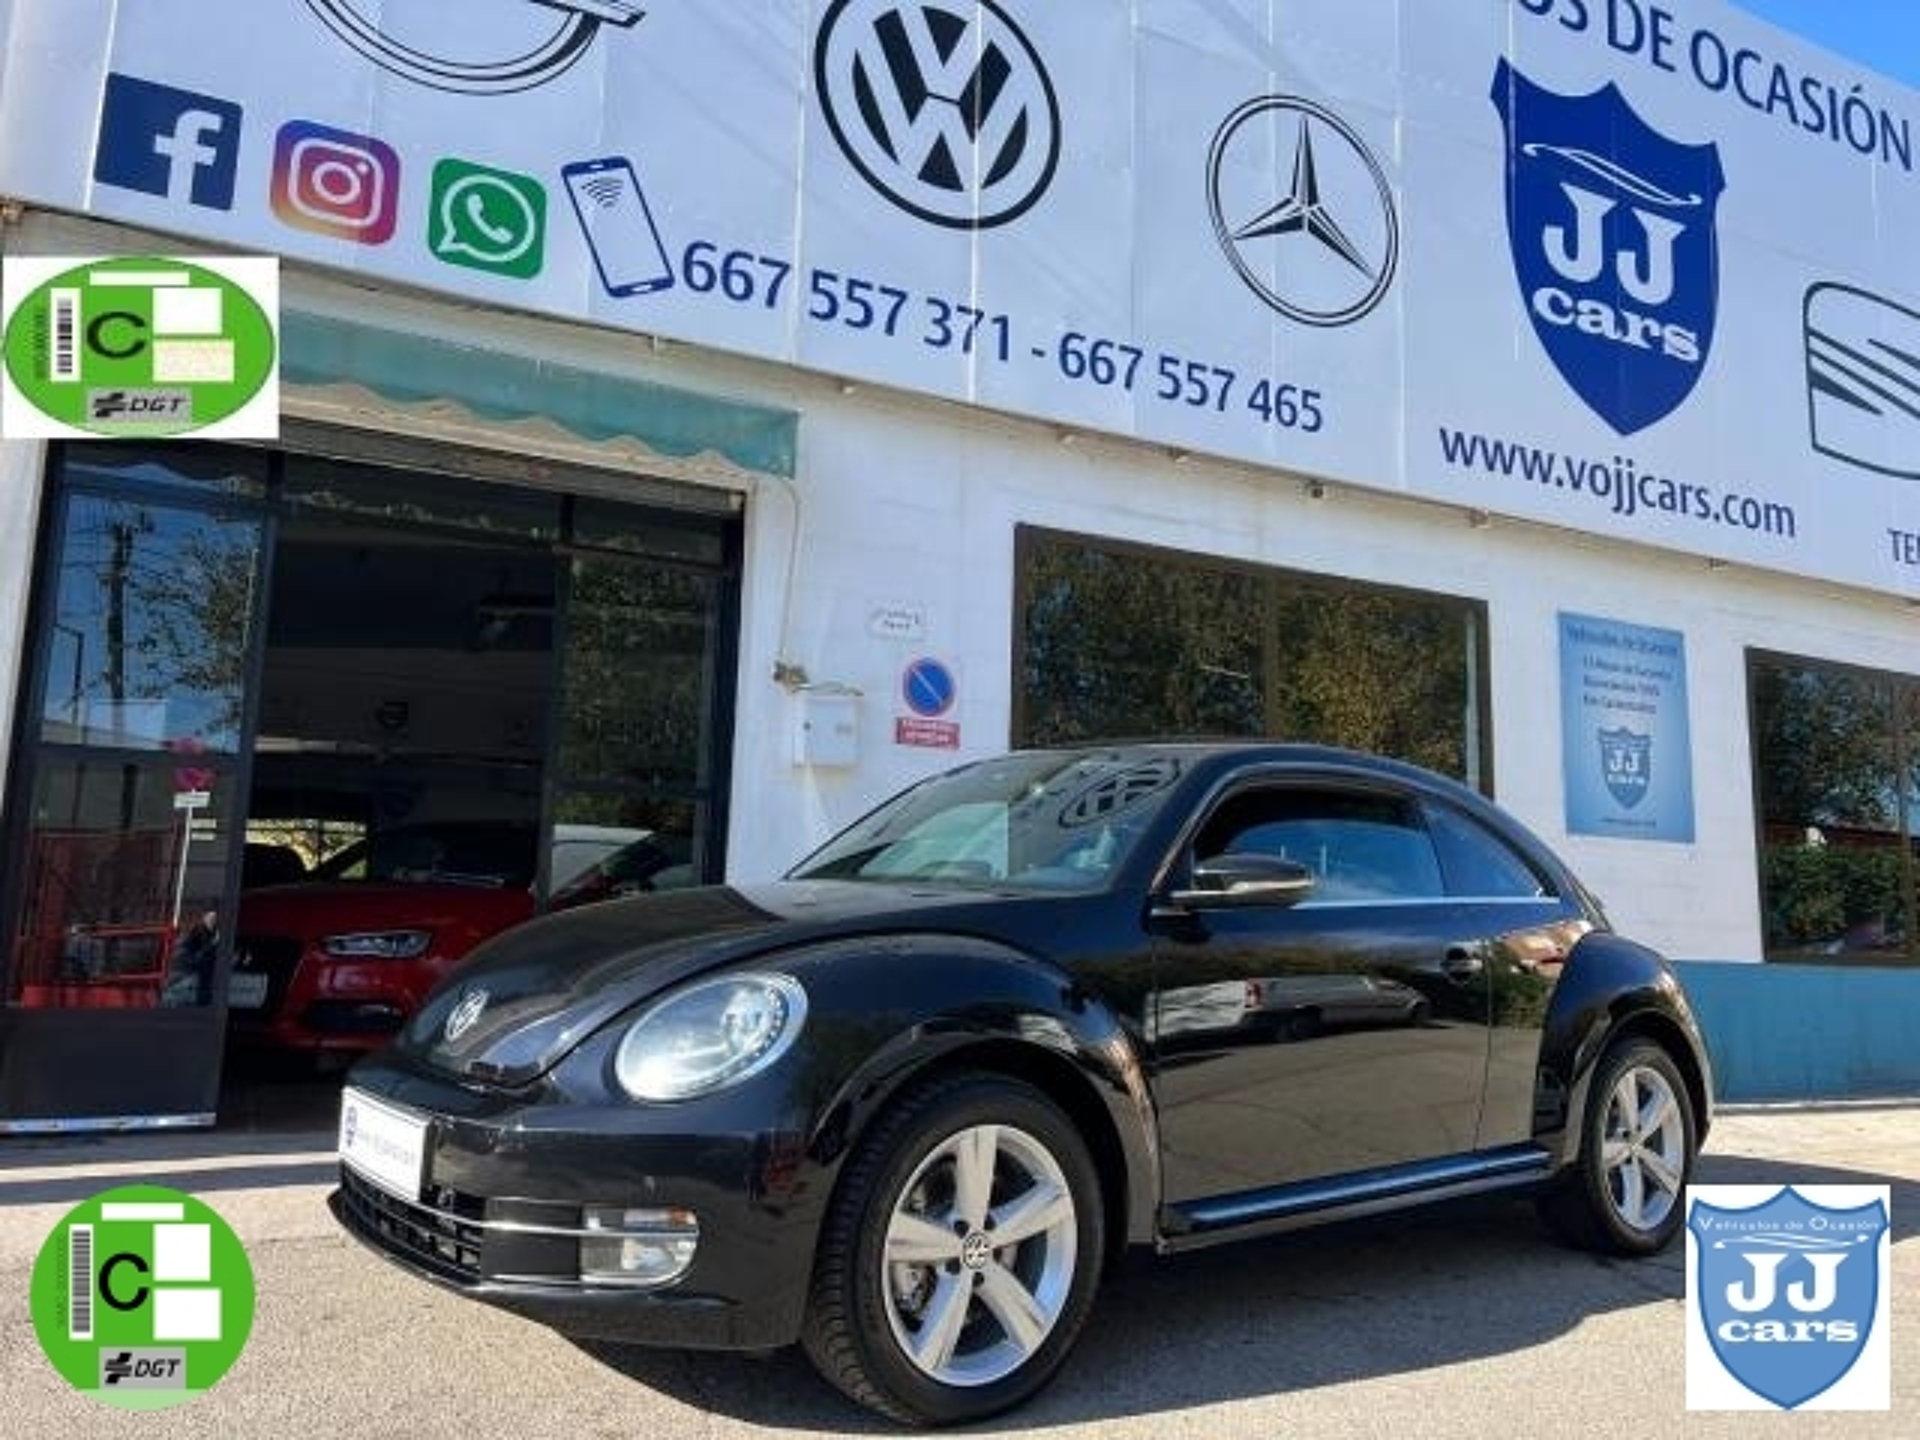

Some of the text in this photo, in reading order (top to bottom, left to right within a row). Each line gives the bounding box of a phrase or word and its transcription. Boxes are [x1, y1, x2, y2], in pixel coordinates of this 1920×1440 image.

[1607, 0, 1676, 72] DE
[1690, 29, 1911, 171] OCASIÓN
[1542, 182, 1686, 305] JJ
[682, 240, 791, 308] 667
[809, 269, 907, 336] 557
[924, 296, 1010, 361] 371
[1058, 332, 1143, 391] 667
[1157, 354, 1236, 412] 557
[1247, 378, 1323, 432] 465
[1533, 287, 1699, 362] cars
[1439, 427, 1796, 538] www.vojjcars.com
[1886, 527, 1920, 565] TE
